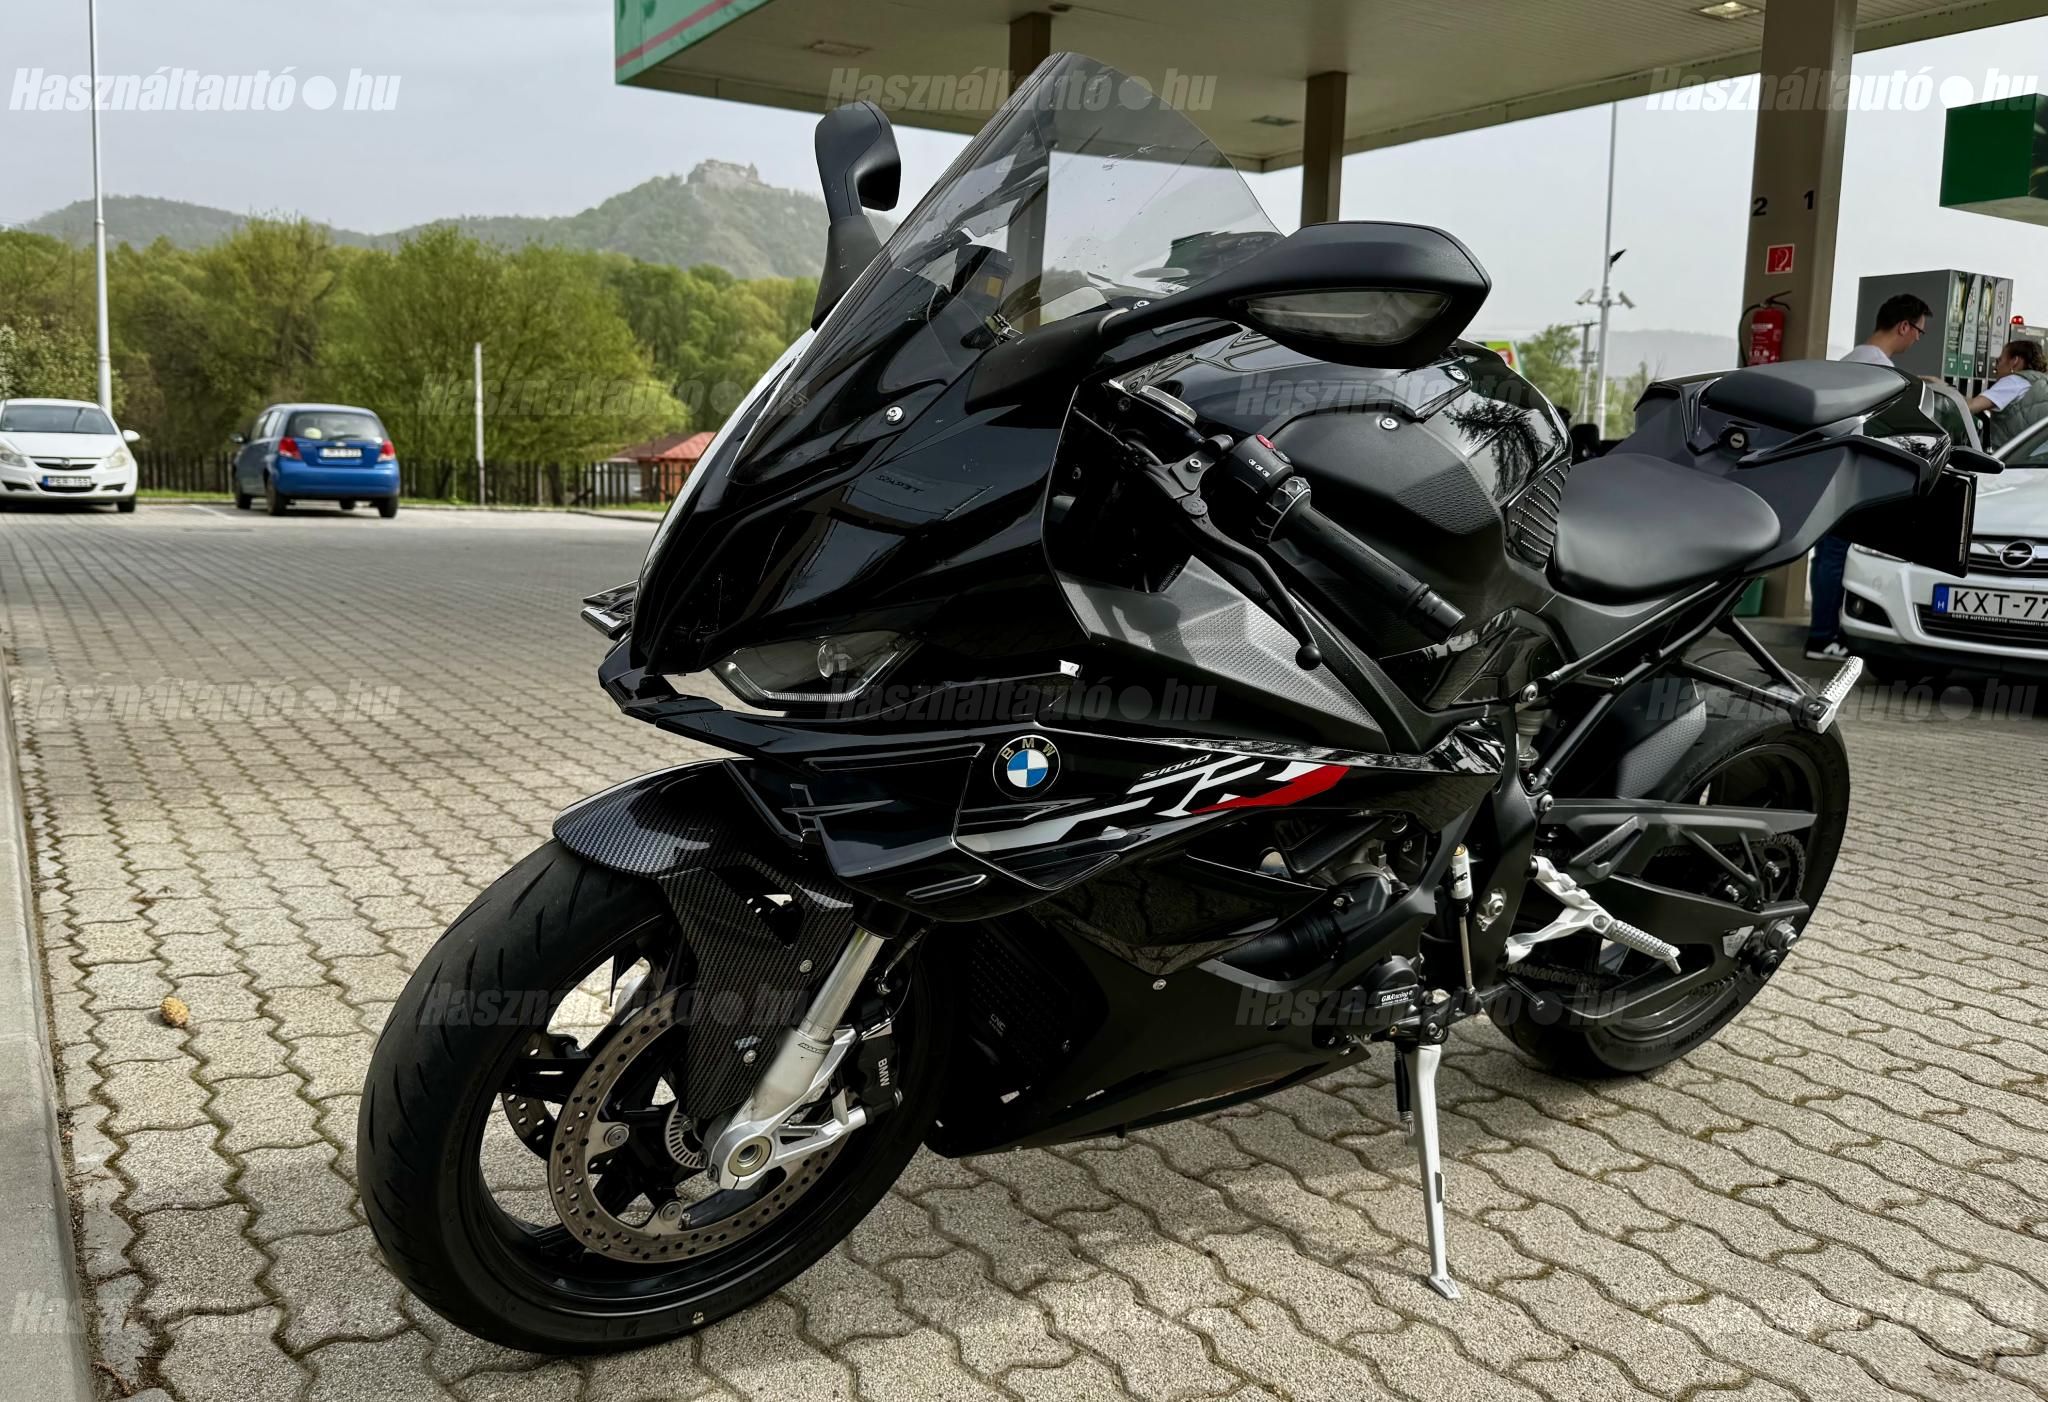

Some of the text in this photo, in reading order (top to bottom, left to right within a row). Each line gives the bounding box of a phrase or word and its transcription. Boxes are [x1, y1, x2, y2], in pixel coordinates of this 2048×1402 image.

[1752, 197, 1768, 217] 2
[1804, 190, 1815, 210] 1
[1937, 601, 1945, 609] H
[1001, 737, 1056, 760] BMW
[877, 1057, 891, 1087] BMW
